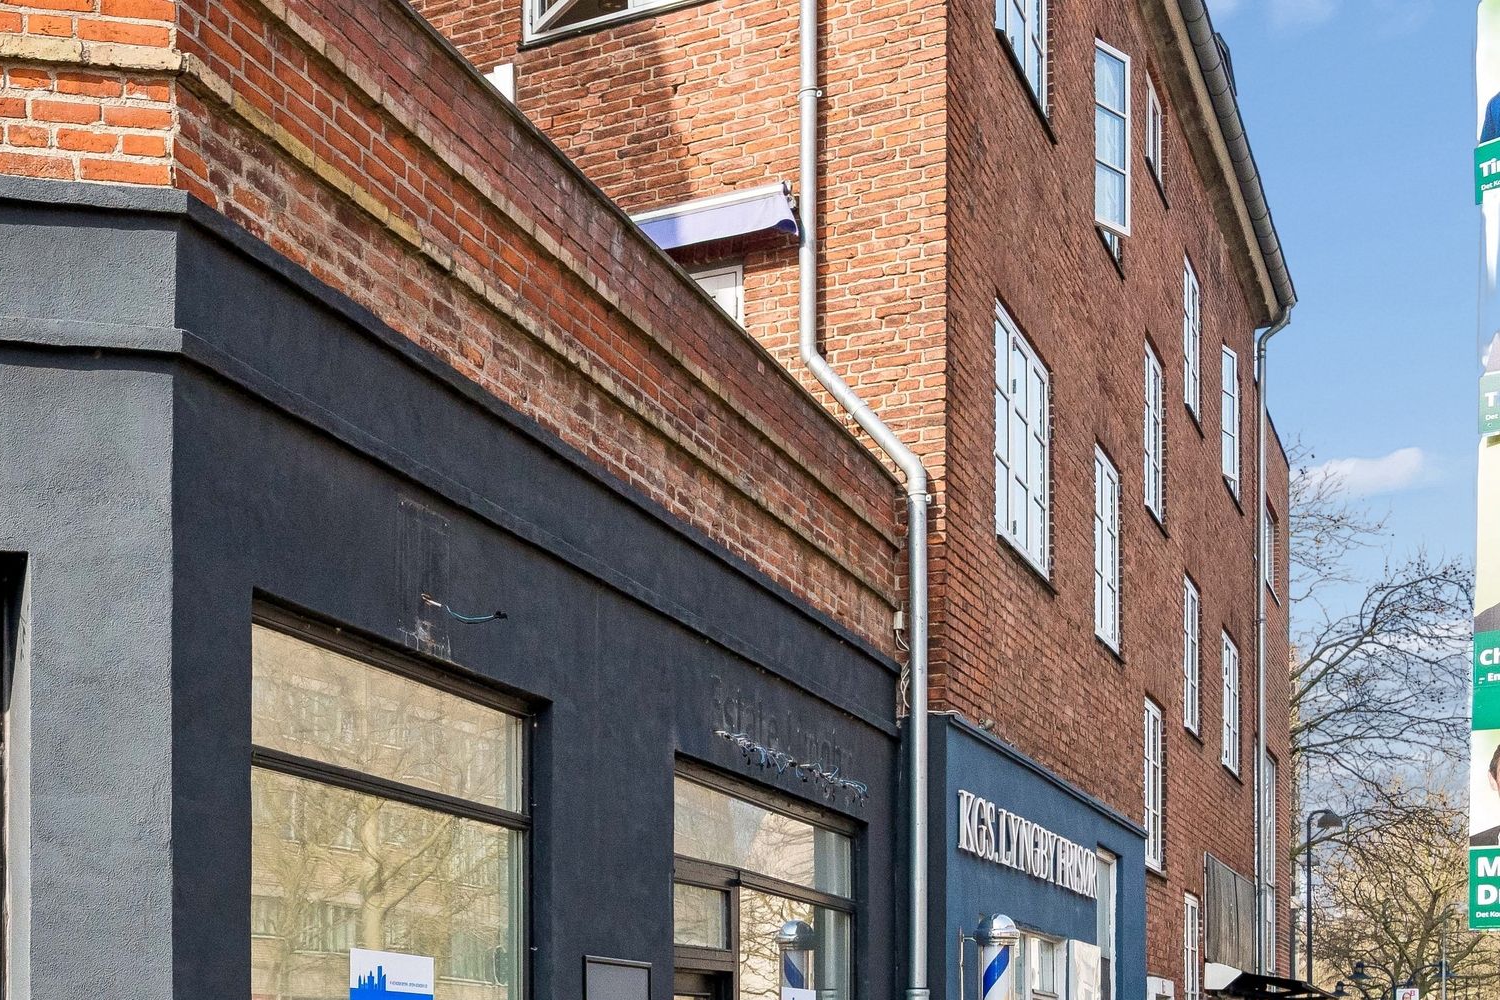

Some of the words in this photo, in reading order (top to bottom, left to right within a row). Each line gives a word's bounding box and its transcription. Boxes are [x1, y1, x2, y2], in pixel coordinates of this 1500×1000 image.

[1479, 157, 1500, 178] Ti
[958, 790, 998, 862] KGS.
[998, 808, 1057, 883] LYNGBY
[1477, 884, 1500, 906] D
